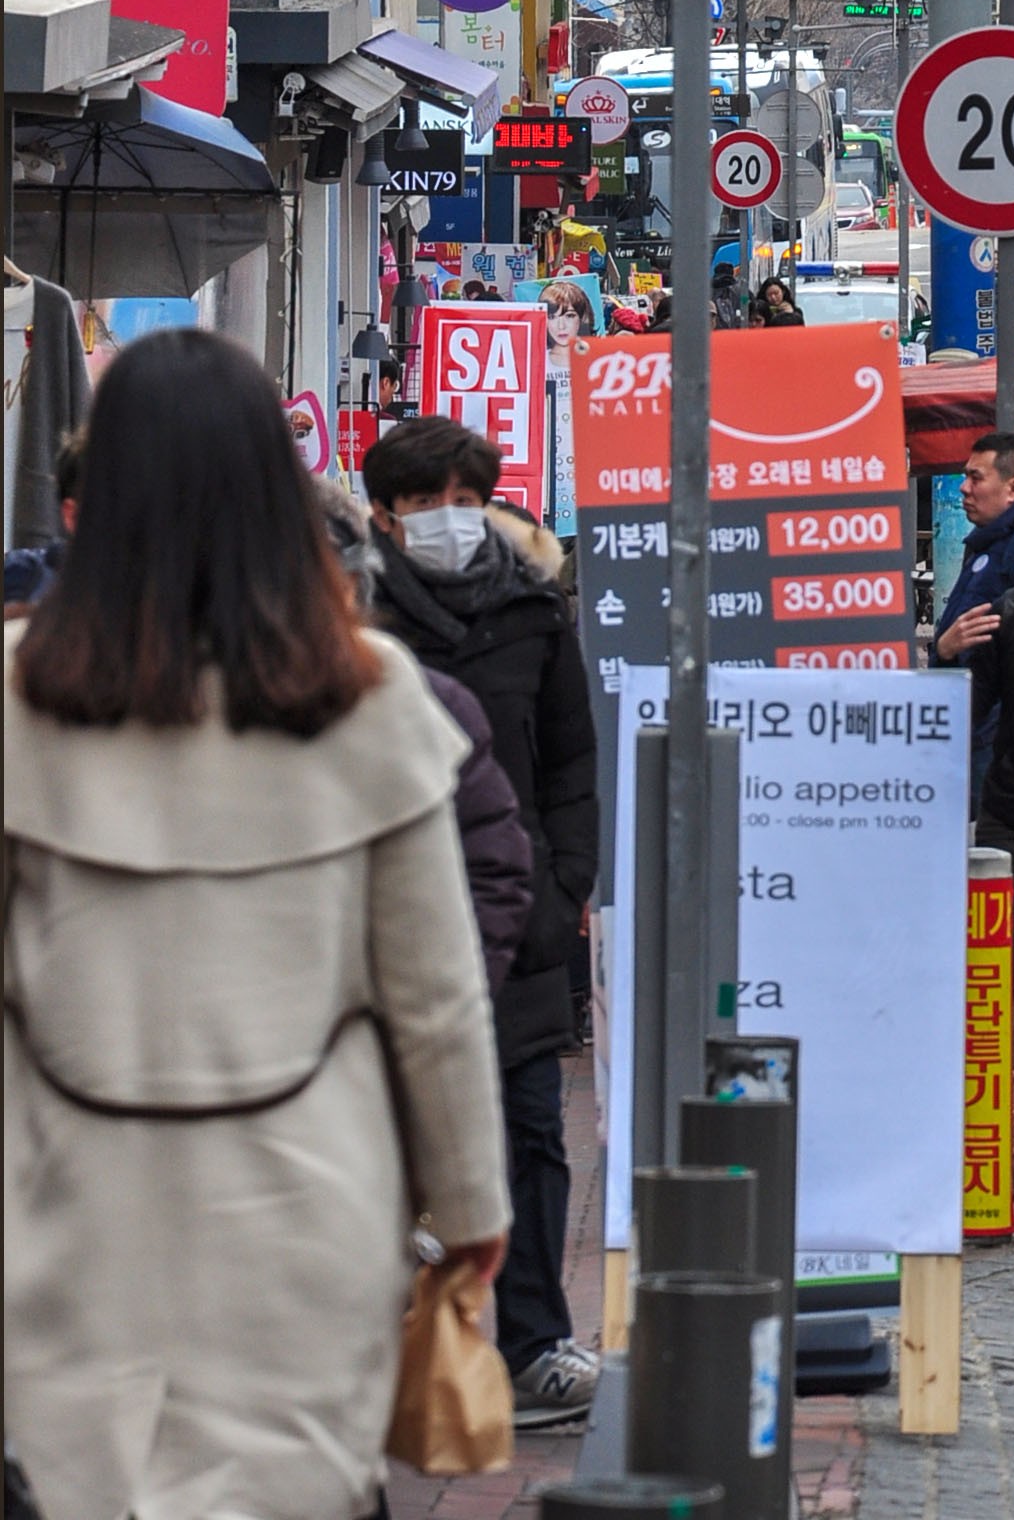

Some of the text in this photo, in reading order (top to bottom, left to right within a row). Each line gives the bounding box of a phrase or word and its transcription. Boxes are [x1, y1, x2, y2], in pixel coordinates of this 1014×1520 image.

[728, 154, 761, 185] 20
[976, 289, 994, 330] 불법
[447, 327, 519, 391] SA
[589, 400, 662, 416] NAIL
[748, 459, 811, 487] 오래된
[782, 513, 889, 549] 12,000
[596, 589, 626, 625] 손
[783, 578, 893, 613] 35,000
[808, 701, 952, 744] 아뻬띠또
[795, 779, 936, 807] appetito
[788, 814, 834, 828] close
[840, 817, 868, 831] pm
[875, 815, 922, 828] 10:00
[964, 1123, 1001, 1196] 금지
